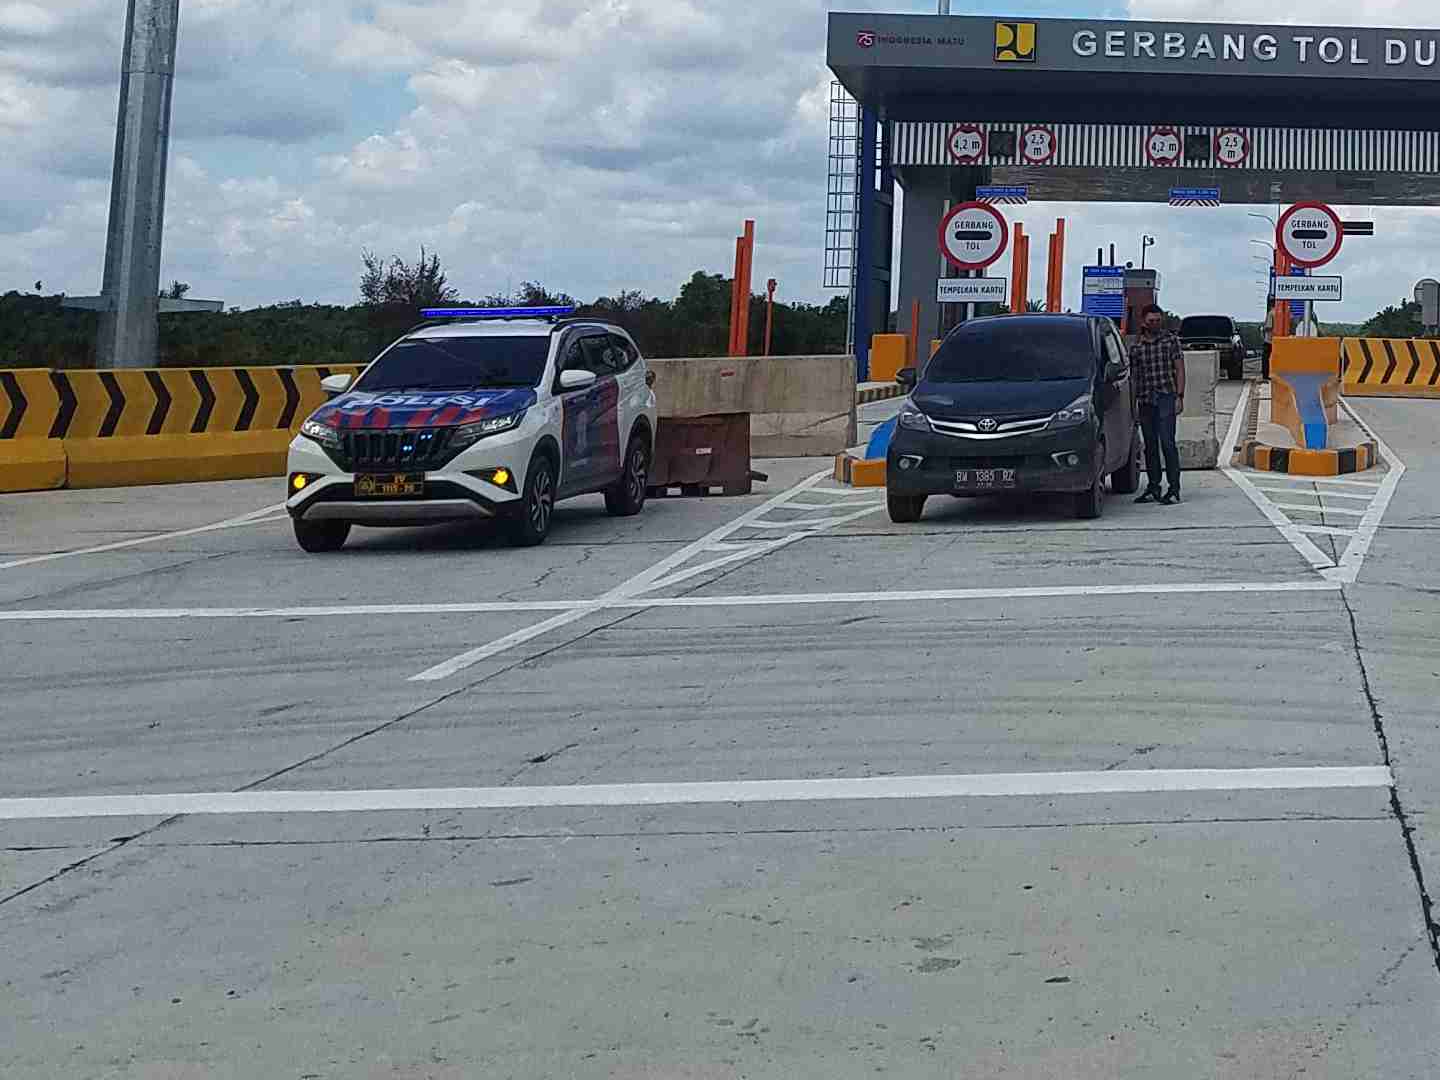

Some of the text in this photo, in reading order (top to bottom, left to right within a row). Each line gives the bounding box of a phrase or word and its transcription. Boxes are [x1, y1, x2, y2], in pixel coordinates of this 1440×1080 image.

[1072, 29, 1279, 62] GERBANG
[1293, 36, 1369, 64] TOL
[971, 140, 980, 150] m
[1168, 142, 1177, 152] m
[1033, 147, 1042, 156] m
[1227, 150, 1236, 159] m
[954, 221, 994, 230] GERBANG
[1291, 220, 1329, 229] GERBANG
[965, 242, 981, 250] TOL
[1302, 241, 1317, 249] TOL
[939, 286, 1004, 295] TEMPELKAN KARTU
[1278, 283, 1339, 293] TEMPELKAN KARTU
[342, 392, 491, 409] POLISI
